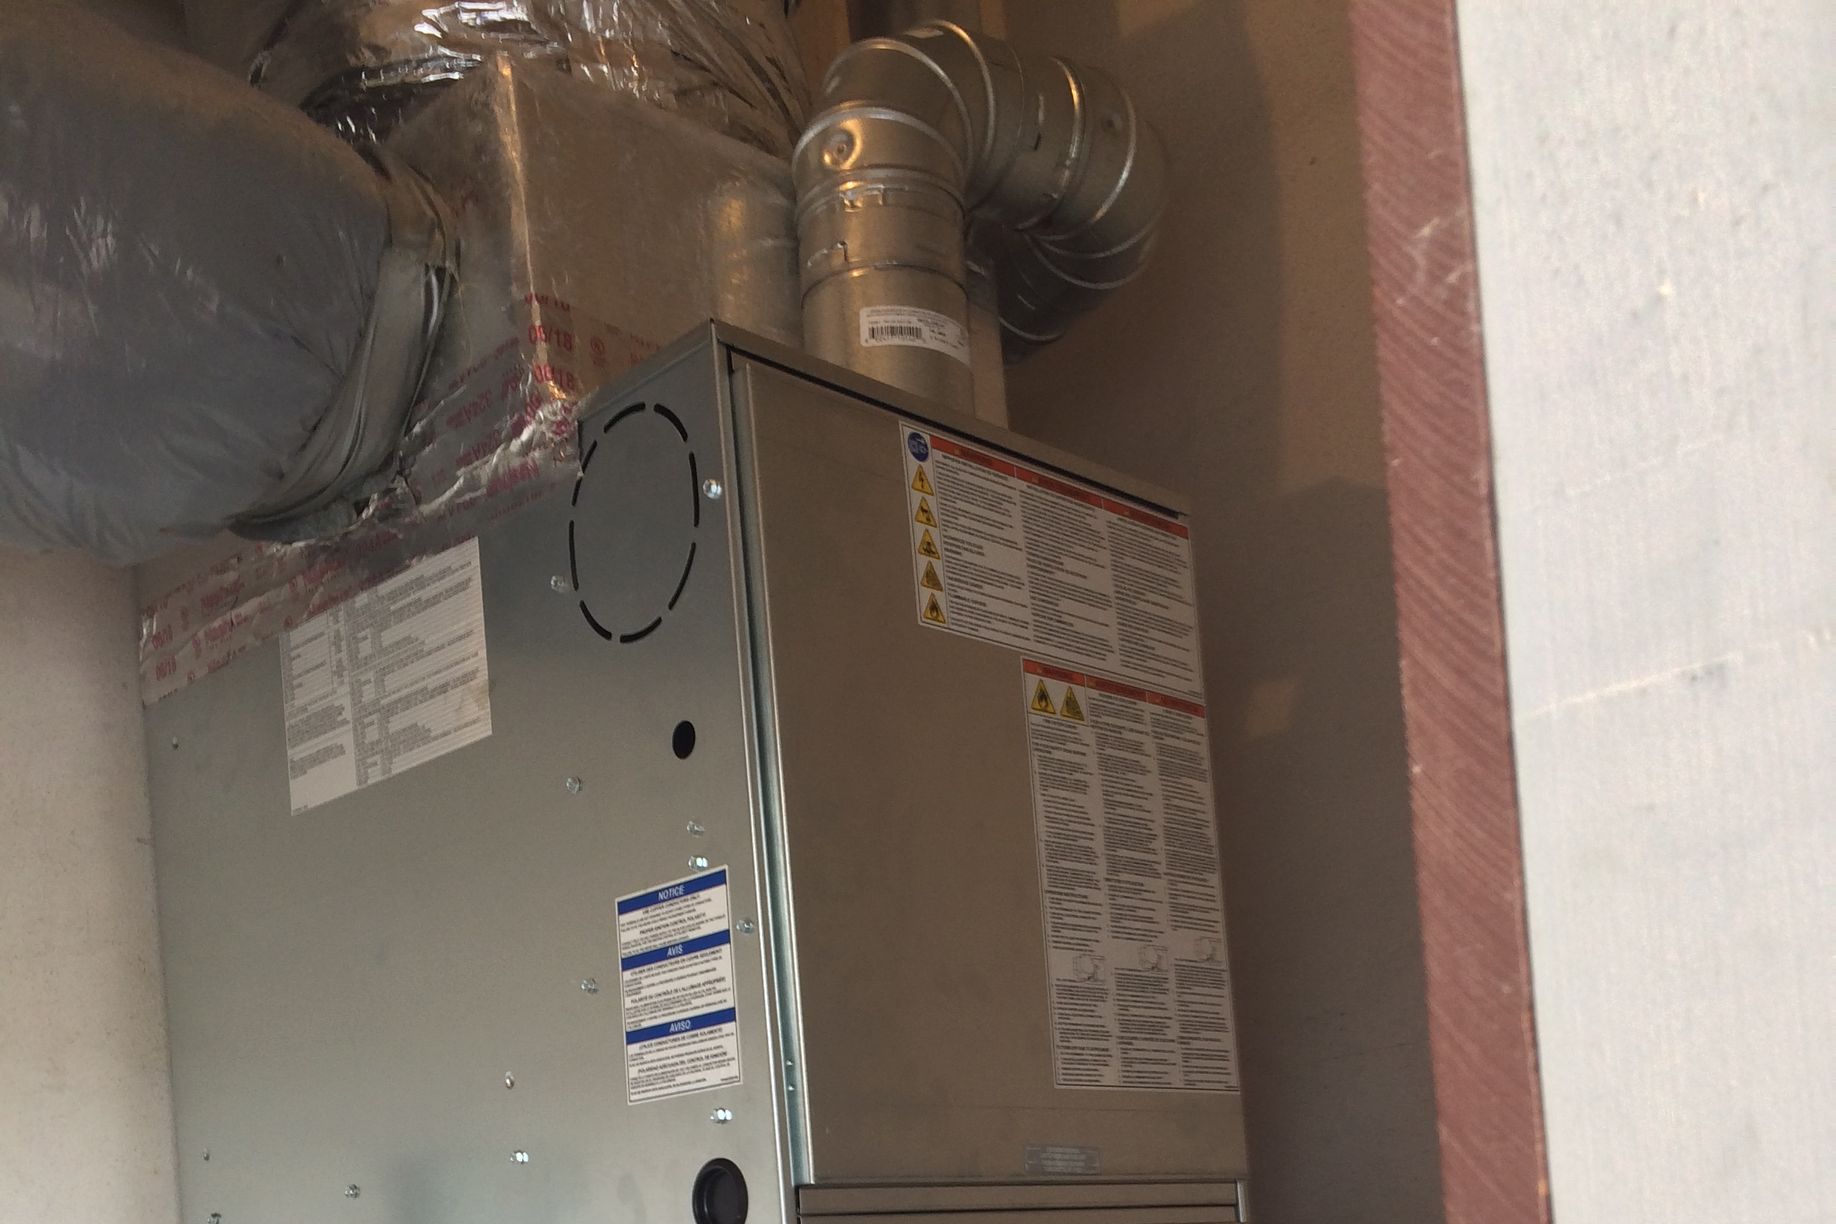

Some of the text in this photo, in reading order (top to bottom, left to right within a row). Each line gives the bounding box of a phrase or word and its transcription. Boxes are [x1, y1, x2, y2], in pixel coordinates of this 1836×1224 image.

[658, 885, 686, 901] NOTICE
[666, 944, 683, 957] AVIS
[669, 1020, 691, 1033] AVISO
